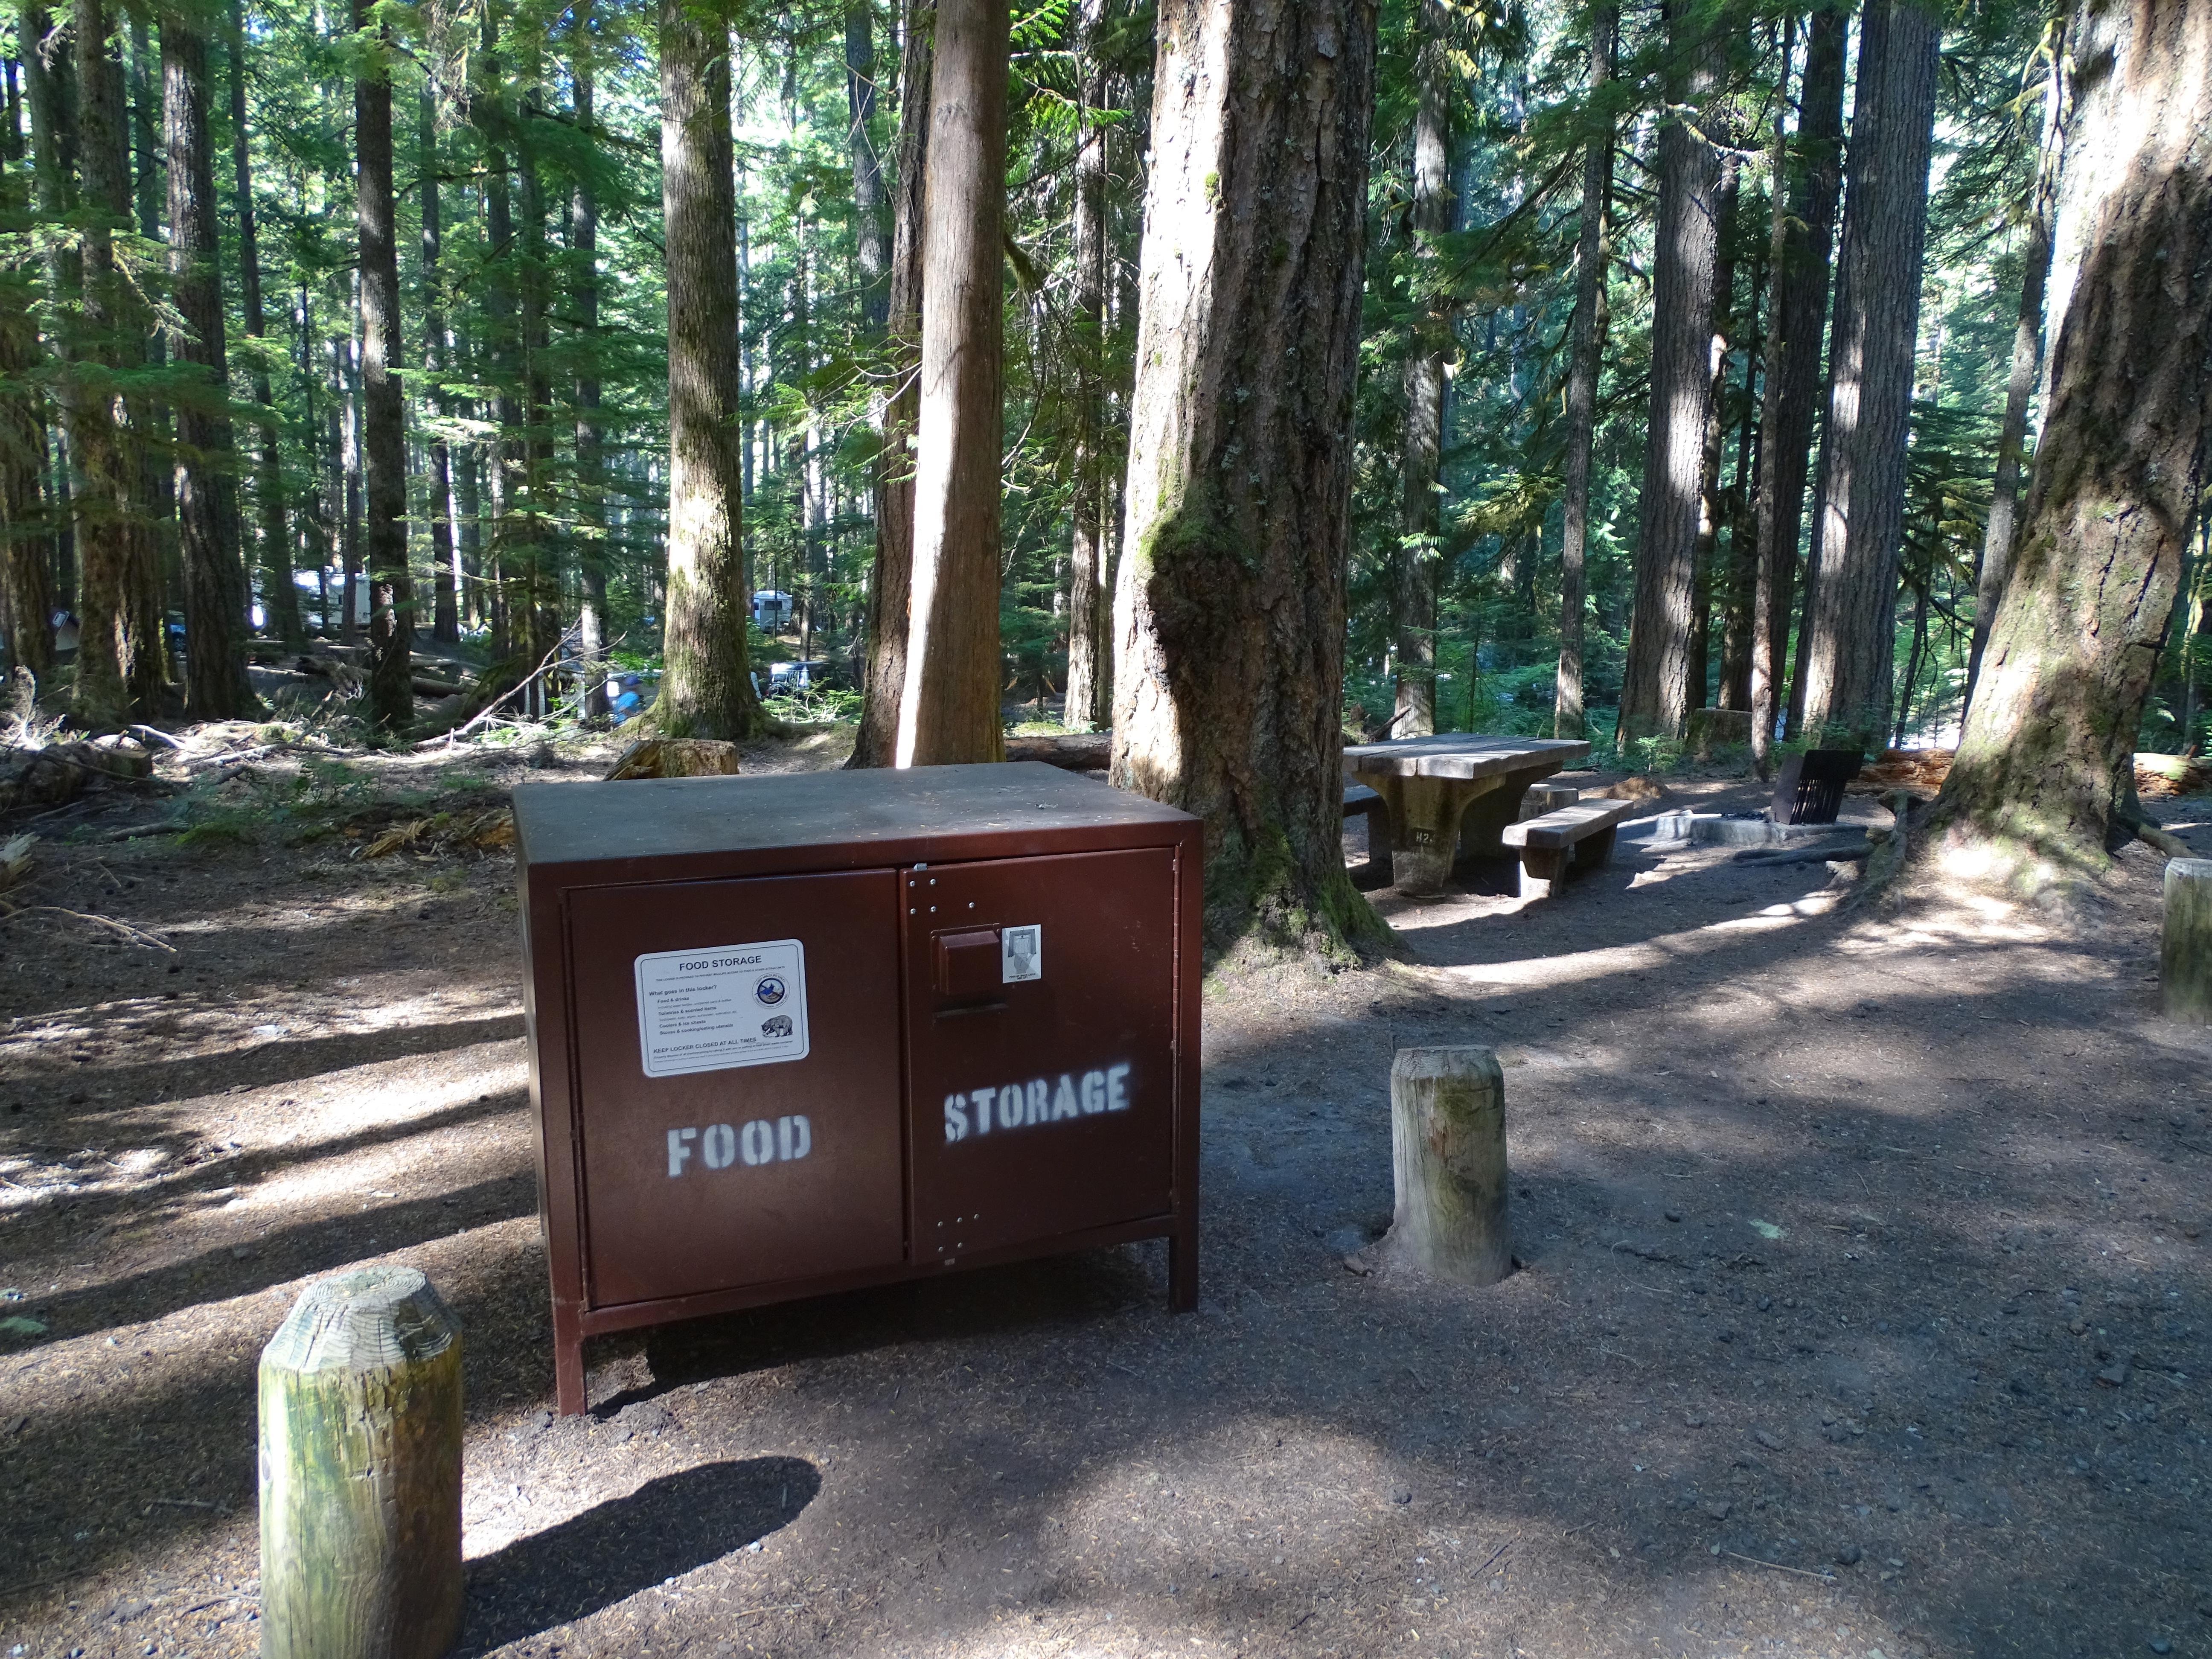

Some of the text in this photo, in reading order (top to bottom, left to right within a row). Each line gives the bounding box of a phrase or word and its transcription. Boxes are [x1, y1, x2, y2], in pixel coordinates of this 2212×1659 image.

[679, 955, 762, 971] FOOD STORAGE
[944, 1062, 1130, 1141] STORAGE
[667, 1115, 811, 1178] FOOD
